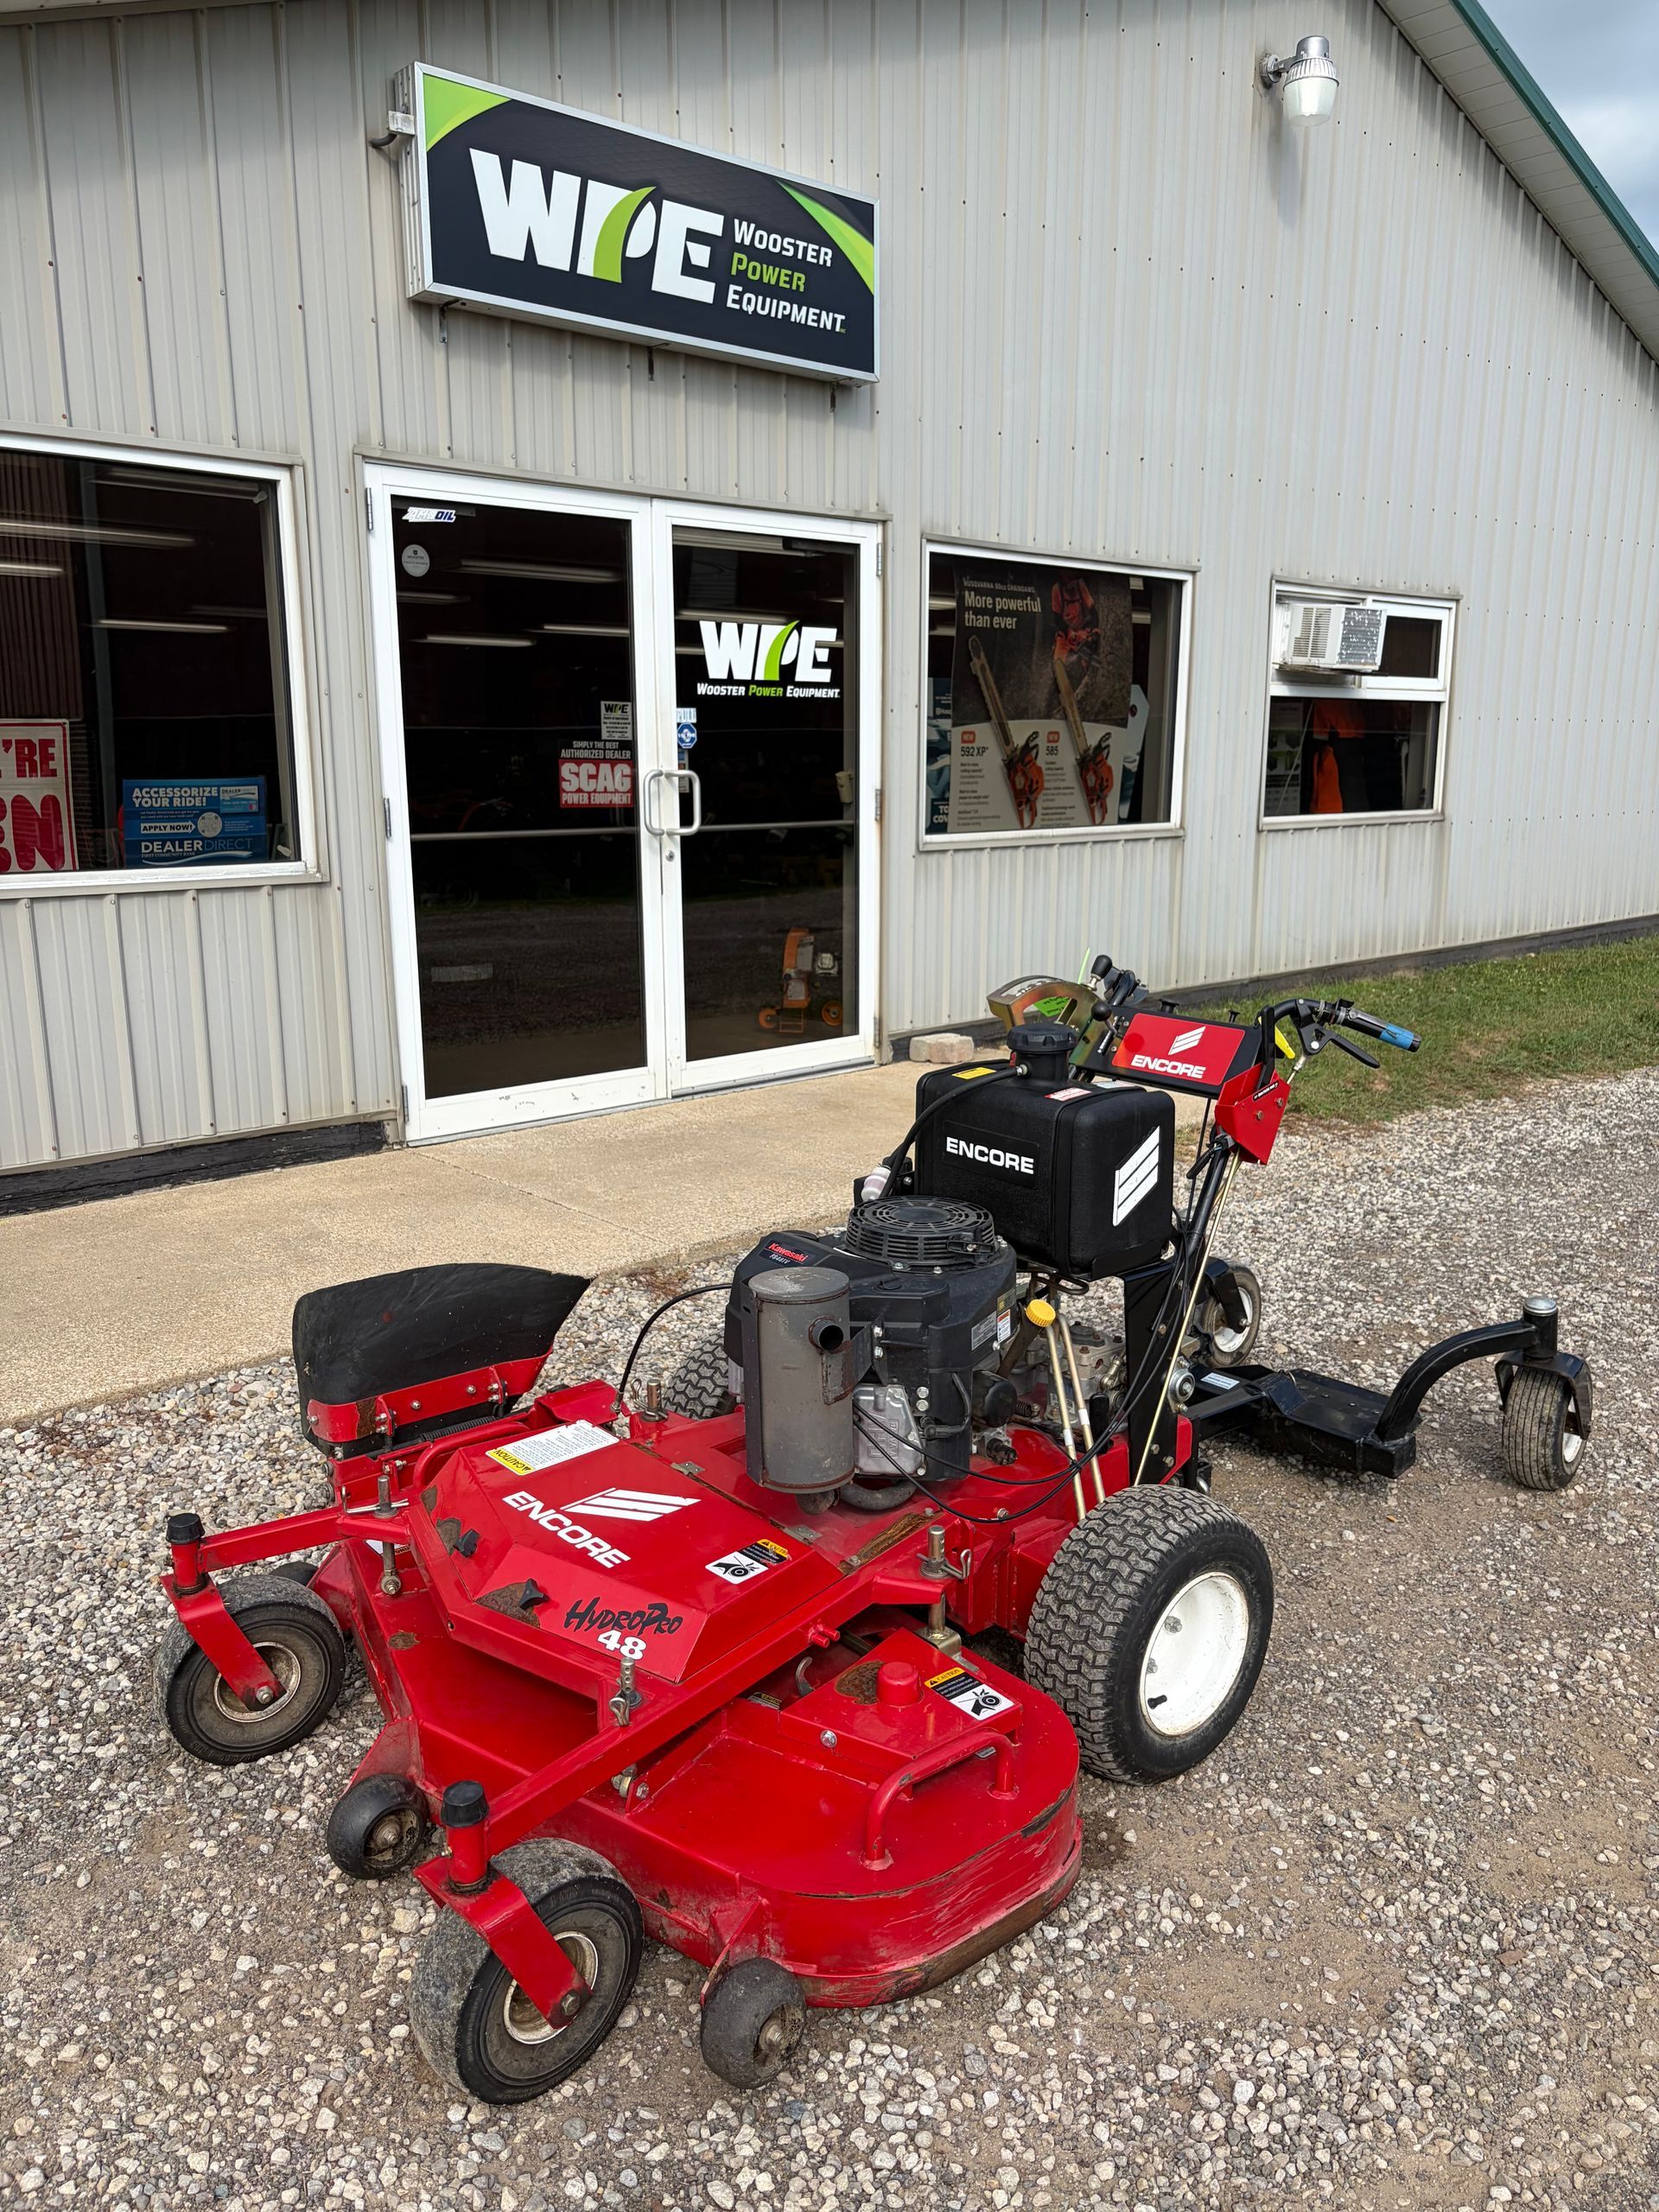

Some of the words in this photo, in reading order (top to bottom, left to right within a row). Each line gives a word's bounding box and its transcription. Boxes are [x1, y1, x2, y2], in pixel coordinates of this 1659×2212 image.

[469, 148, 724, 303] WPE
[403, 508, 455, 522] AMSOIL
[964, 590, 993, 608] More
[995, 596, 1041, 613] powerful
[964, 610, 990, 627] than
[993, 616, 1017, 629] ever
[699, 620, 837, 683] WPE
[561, 749, 603, 759] AUTHORIZED
[606, 750, 631, 760] DEALER
[573, 741, 593, 749] SIMPLY
[961, 747, 975, 757] 592
[1046, 746, 1058, 756] 585
[0, 739, 57, 778] 'RE
[562, 763, 631, 791] SCAG
[132, 787, 218, 798] ACCESSORIZE
[133, 798, 169, 807] YOUR
[173, 797, 207, 807] RIDE!
[563, 793, 588, 804] POWER
[591, 793, 631, 804] EQUIPMENT
[1131, 1054, 1206, 1079] ENCORE
[946, 1136, 1034, 1175] ENCORE
[769, 1243, 809, 1262] Kawasaki
[494, 1448, 526, 1471] CAUTION
[502, 1491, 632, 1568] ENCORE
[597, 1629, 647, 1660] 48
